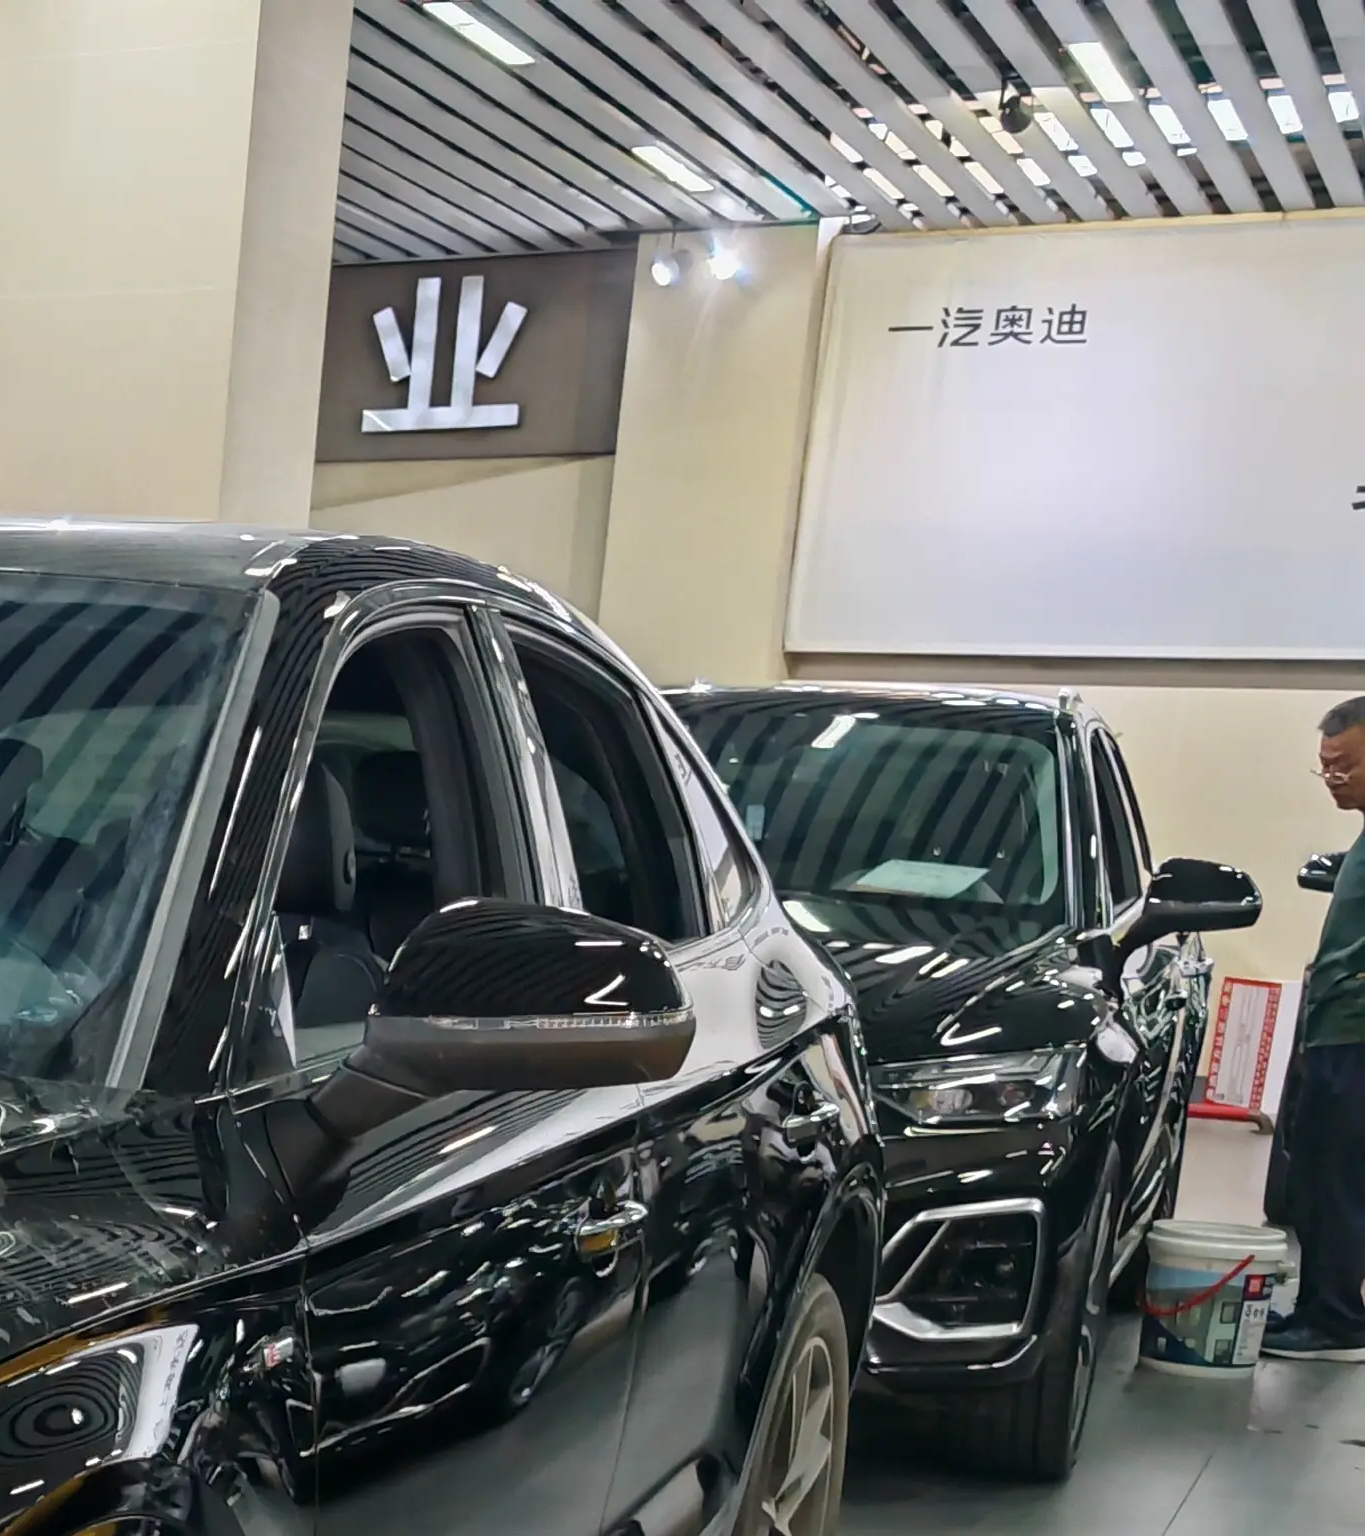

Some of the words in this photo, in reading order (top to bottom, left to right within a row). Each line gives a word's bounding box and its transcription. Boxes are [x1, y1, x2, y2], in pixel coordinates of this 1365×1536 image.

[360, 275, 528, 433] 业
[887, 302, 1088, 348] 一汽奥迪
